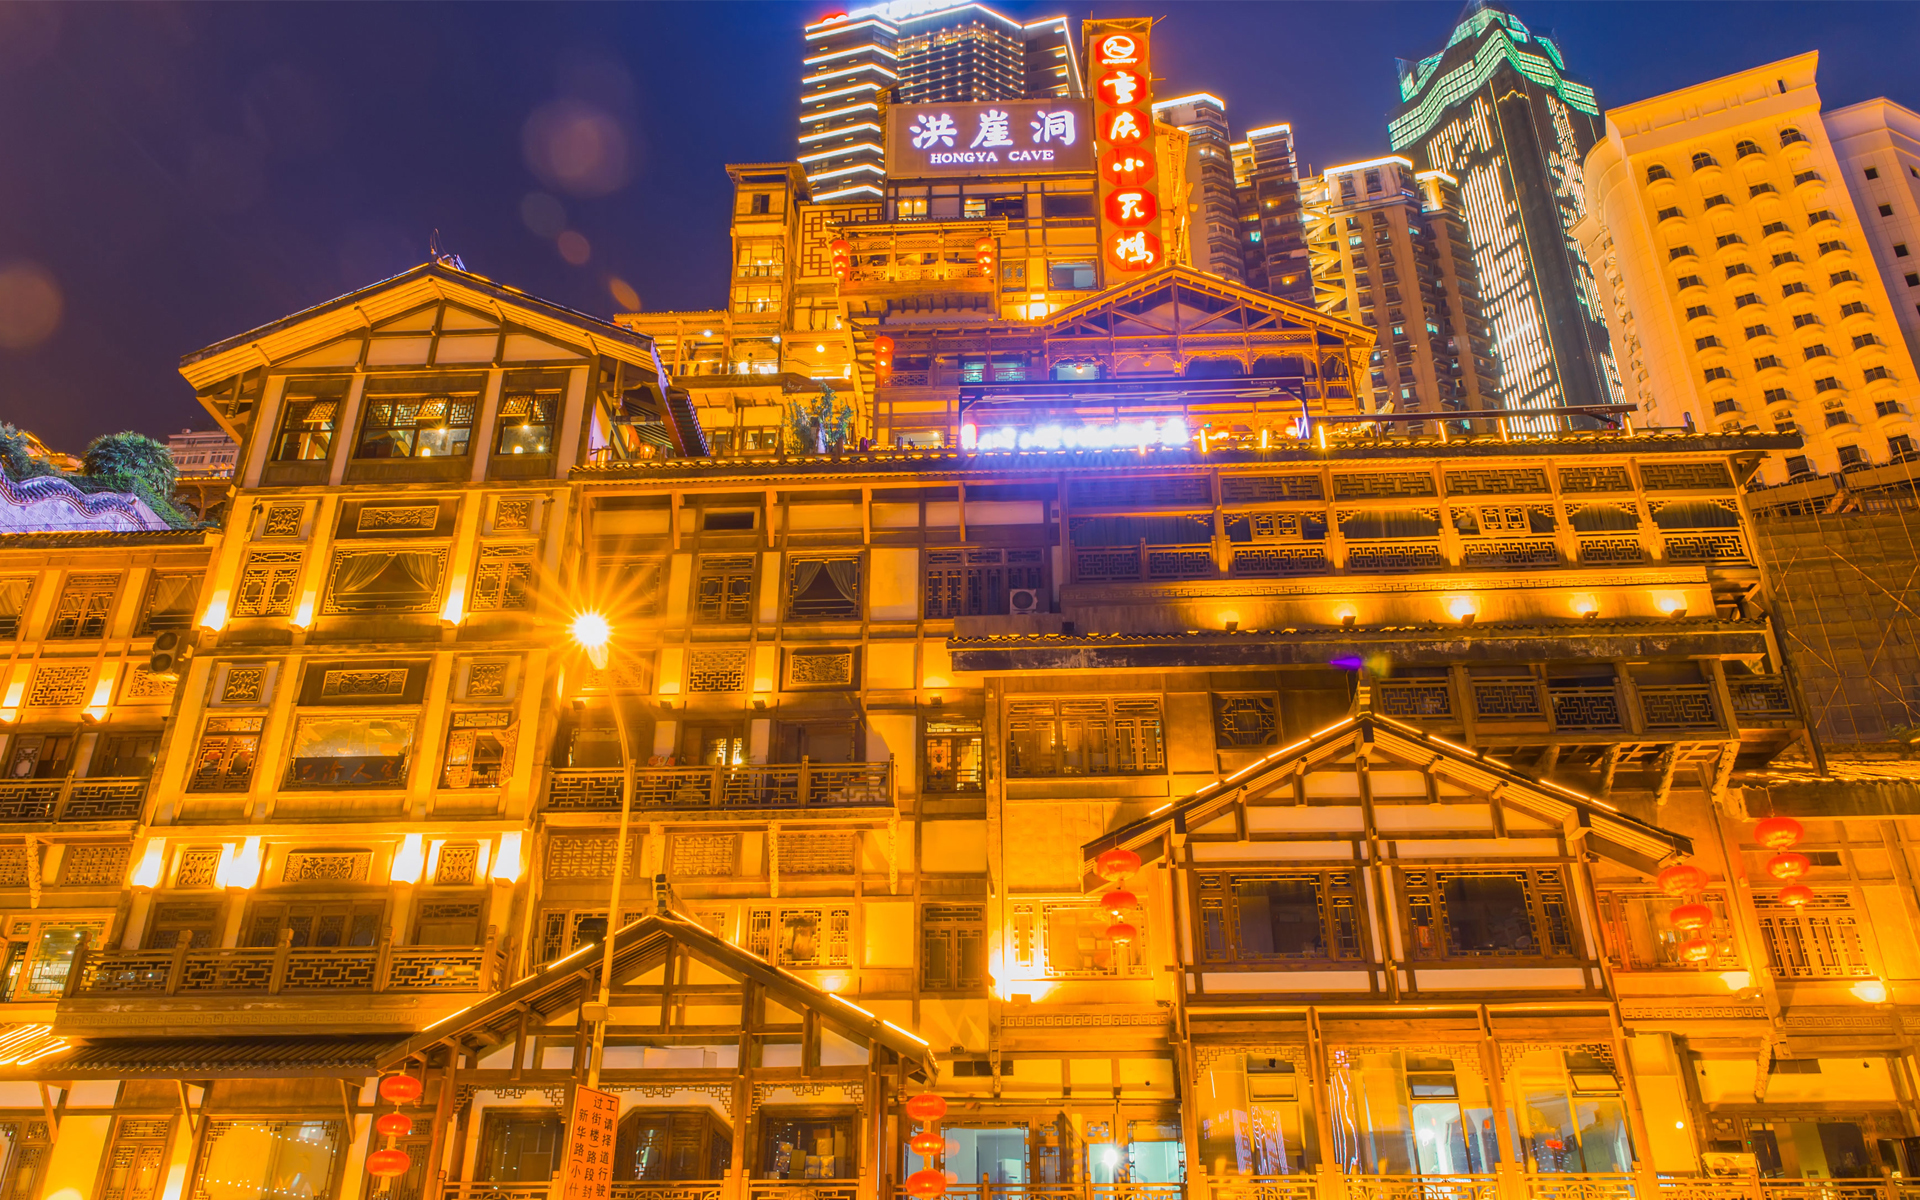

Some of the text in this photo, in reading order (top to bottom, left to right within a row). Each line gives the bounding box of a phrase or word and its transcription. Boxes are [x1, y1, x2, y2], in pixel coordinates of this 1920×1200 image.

[909, 109, 1076, 149] 洪崖洞
[930, 150, 1054, 164] HONGYA CAVE
[1103, 71, 1154, 264] 重庆小天鹅
